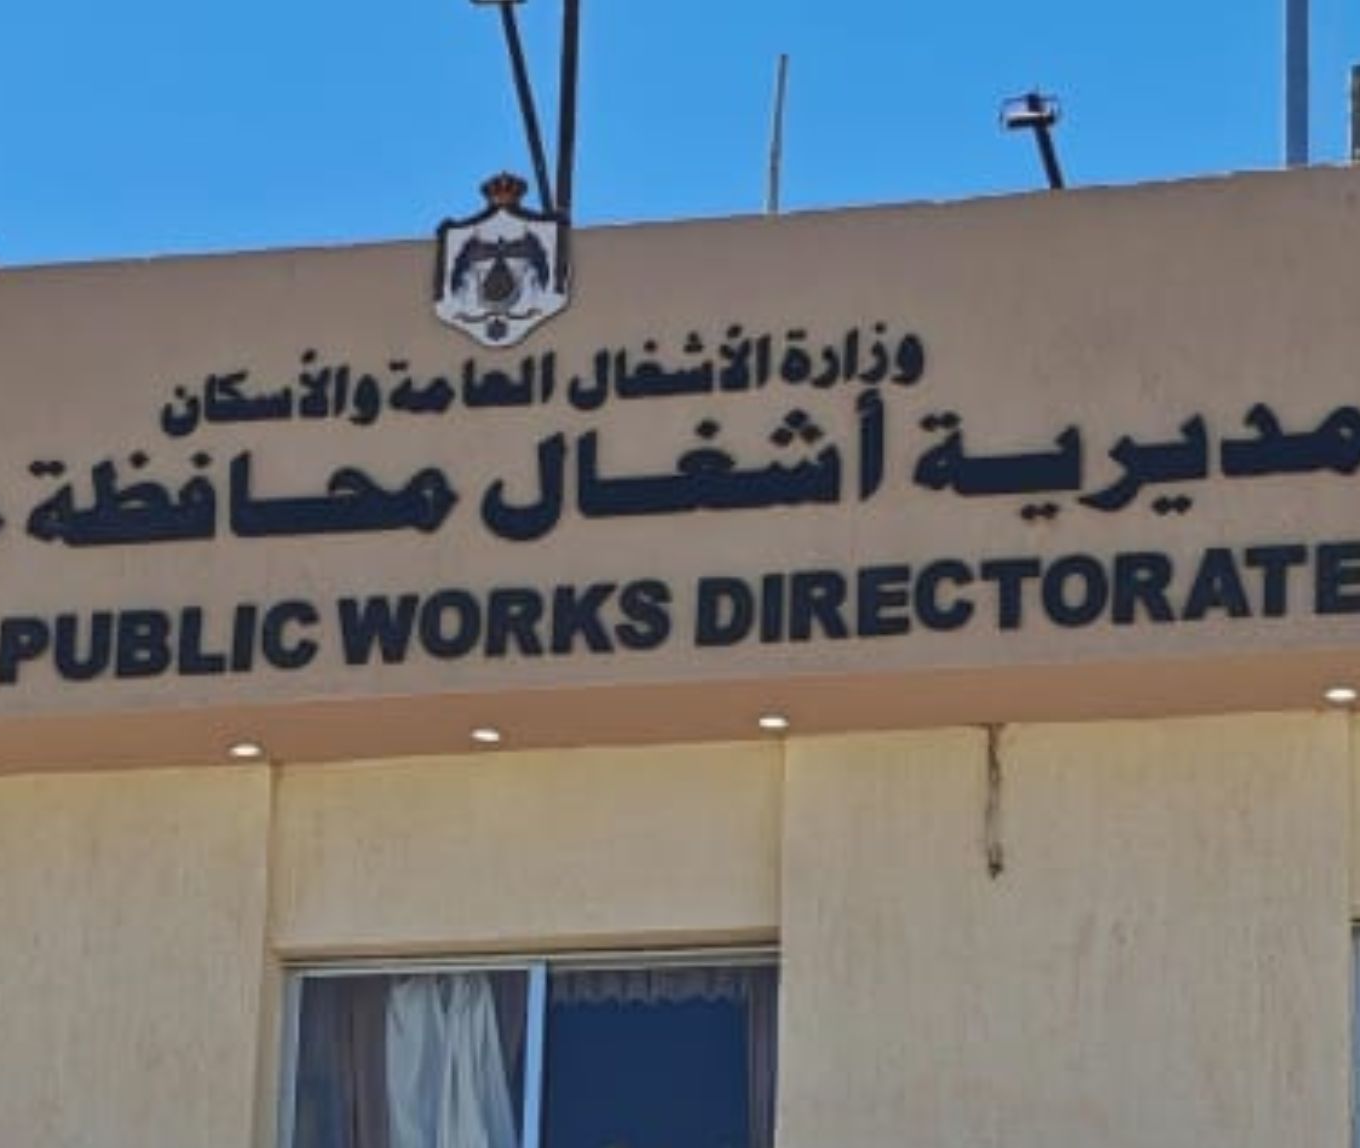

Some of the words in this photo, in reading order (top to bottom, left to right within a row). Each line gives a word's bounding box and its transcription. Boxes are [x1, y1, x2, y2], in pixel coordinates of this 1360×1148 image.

[159, 349, 382, 438] والأسكان
[387, 350, 556, 414] العامة
[567, 324, 772, 412] الأشغال
[779, 322, 925, 389] وزارة
[25, 451, 461, 549] محافظة
[480, 387, 886, 543] أشغال
[337, 579, 673, 666] WORKS
